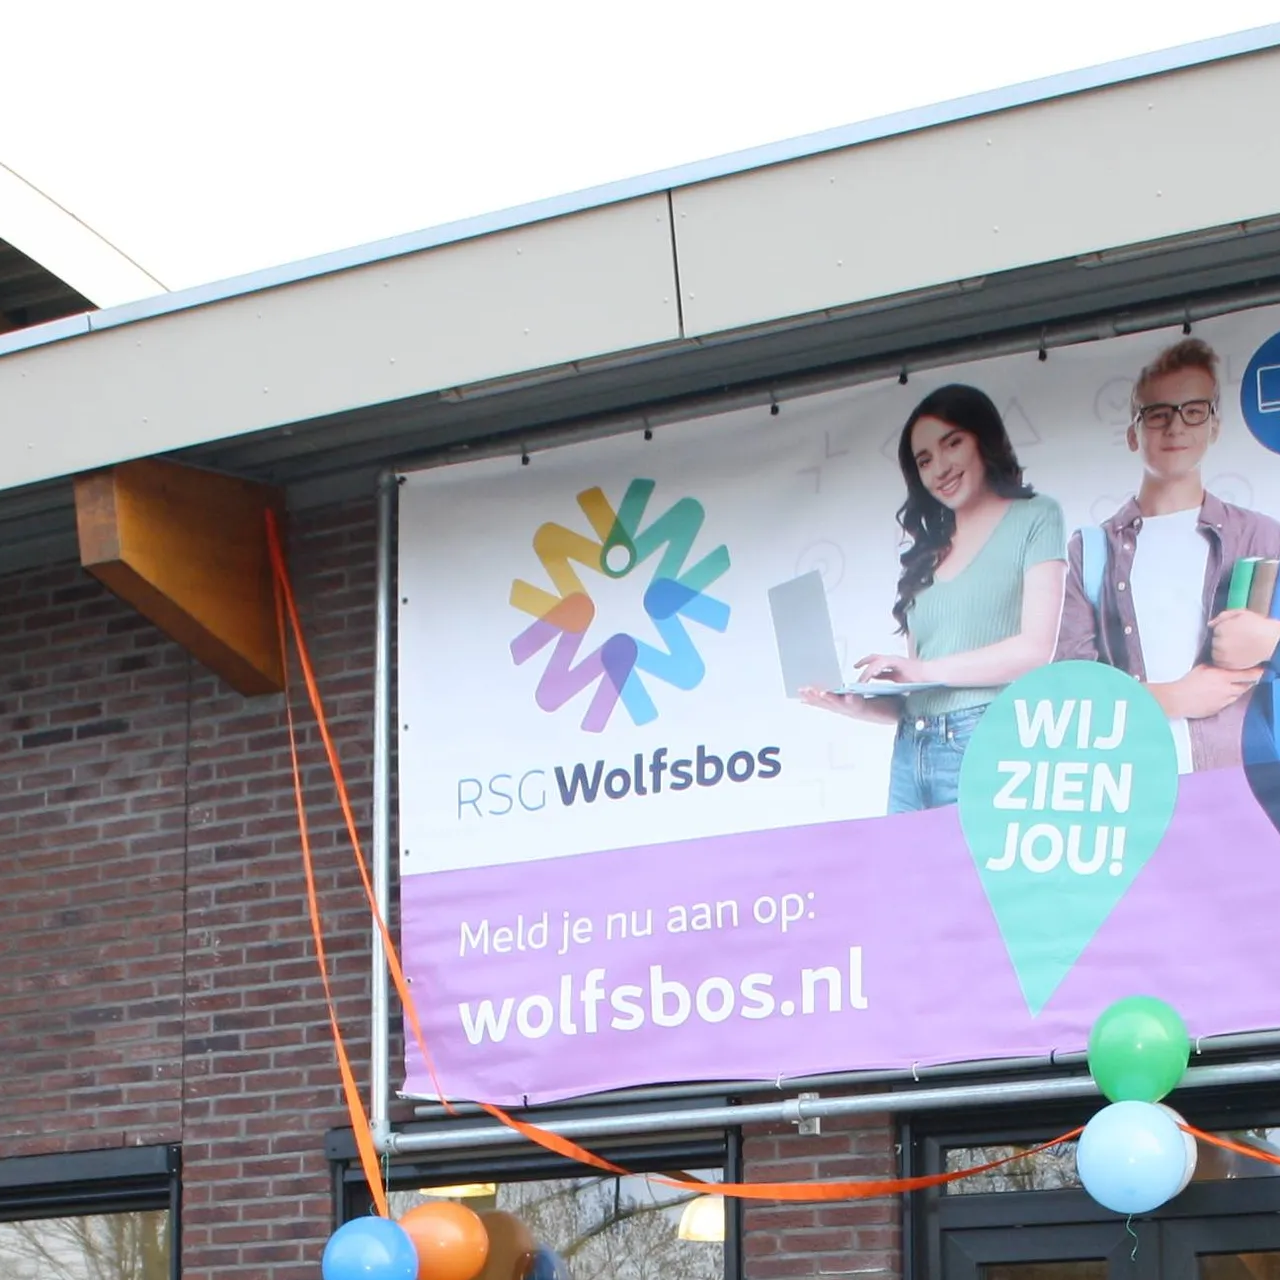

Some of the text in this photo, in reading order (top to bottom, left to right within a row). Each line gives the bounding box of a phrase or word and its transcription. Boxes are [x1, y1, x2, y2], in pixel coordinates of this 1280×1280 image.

[1013, 699, 1128, 750] WIJ
[457, 744, 783, 820] RSG Wolfsbos
[993, 760, 1133, 813] ZIEN
[985, 822, 1127, 877] JOU!
[458, 890, 815, 957] Meld je nu aan op:
[458, 945, 869, 1045] wolfsbos.nl
